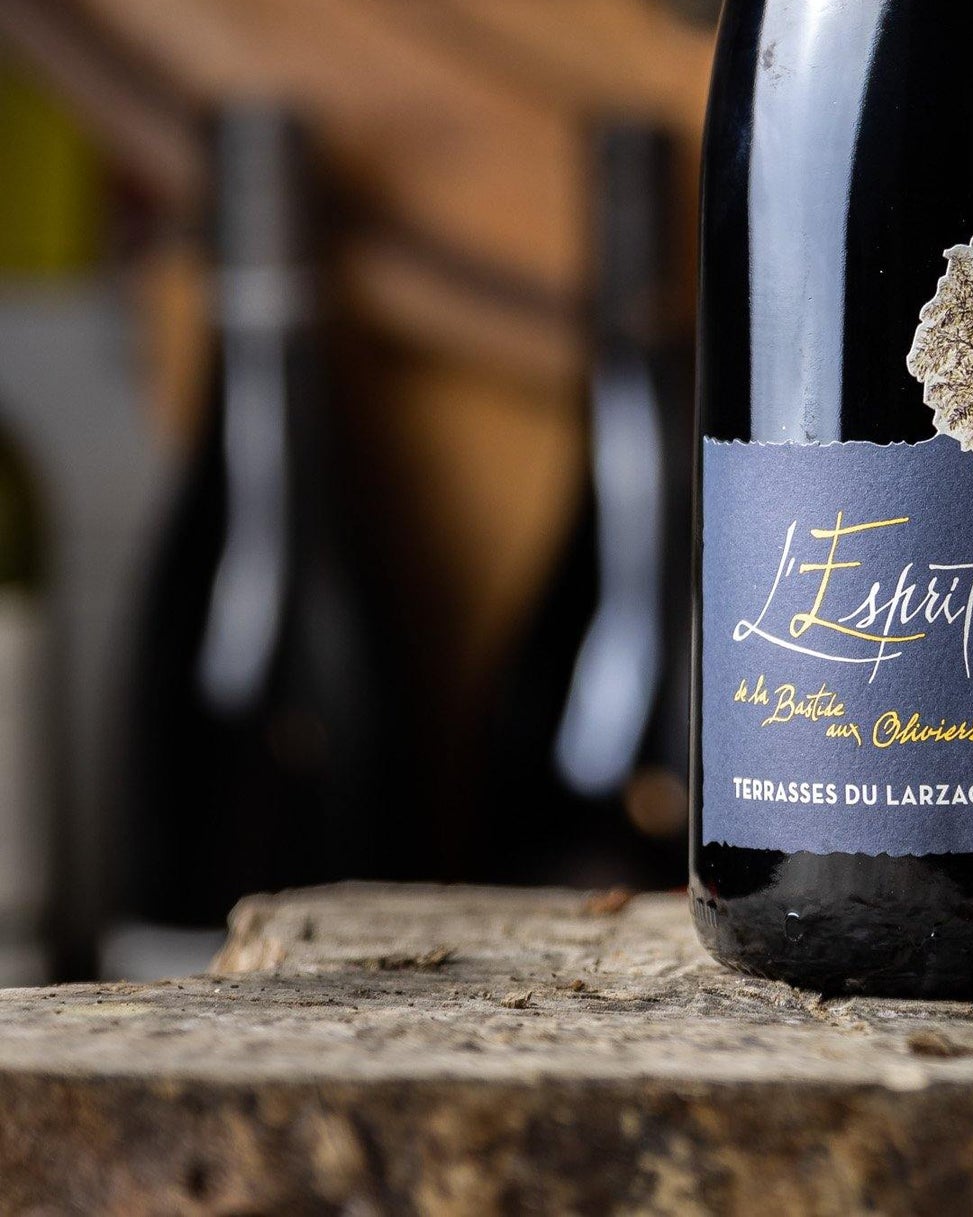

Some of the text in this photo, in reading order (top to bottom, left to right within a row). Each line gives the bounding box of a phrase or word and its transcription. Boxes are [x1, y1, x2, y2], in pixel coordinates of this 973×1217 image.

[733, 674, 845, 727] de la Bastide
[825, 722, 863, 747] aux
[733, 776, 838, 805] TERRASSES
[845, 784, 878, 805] DU
